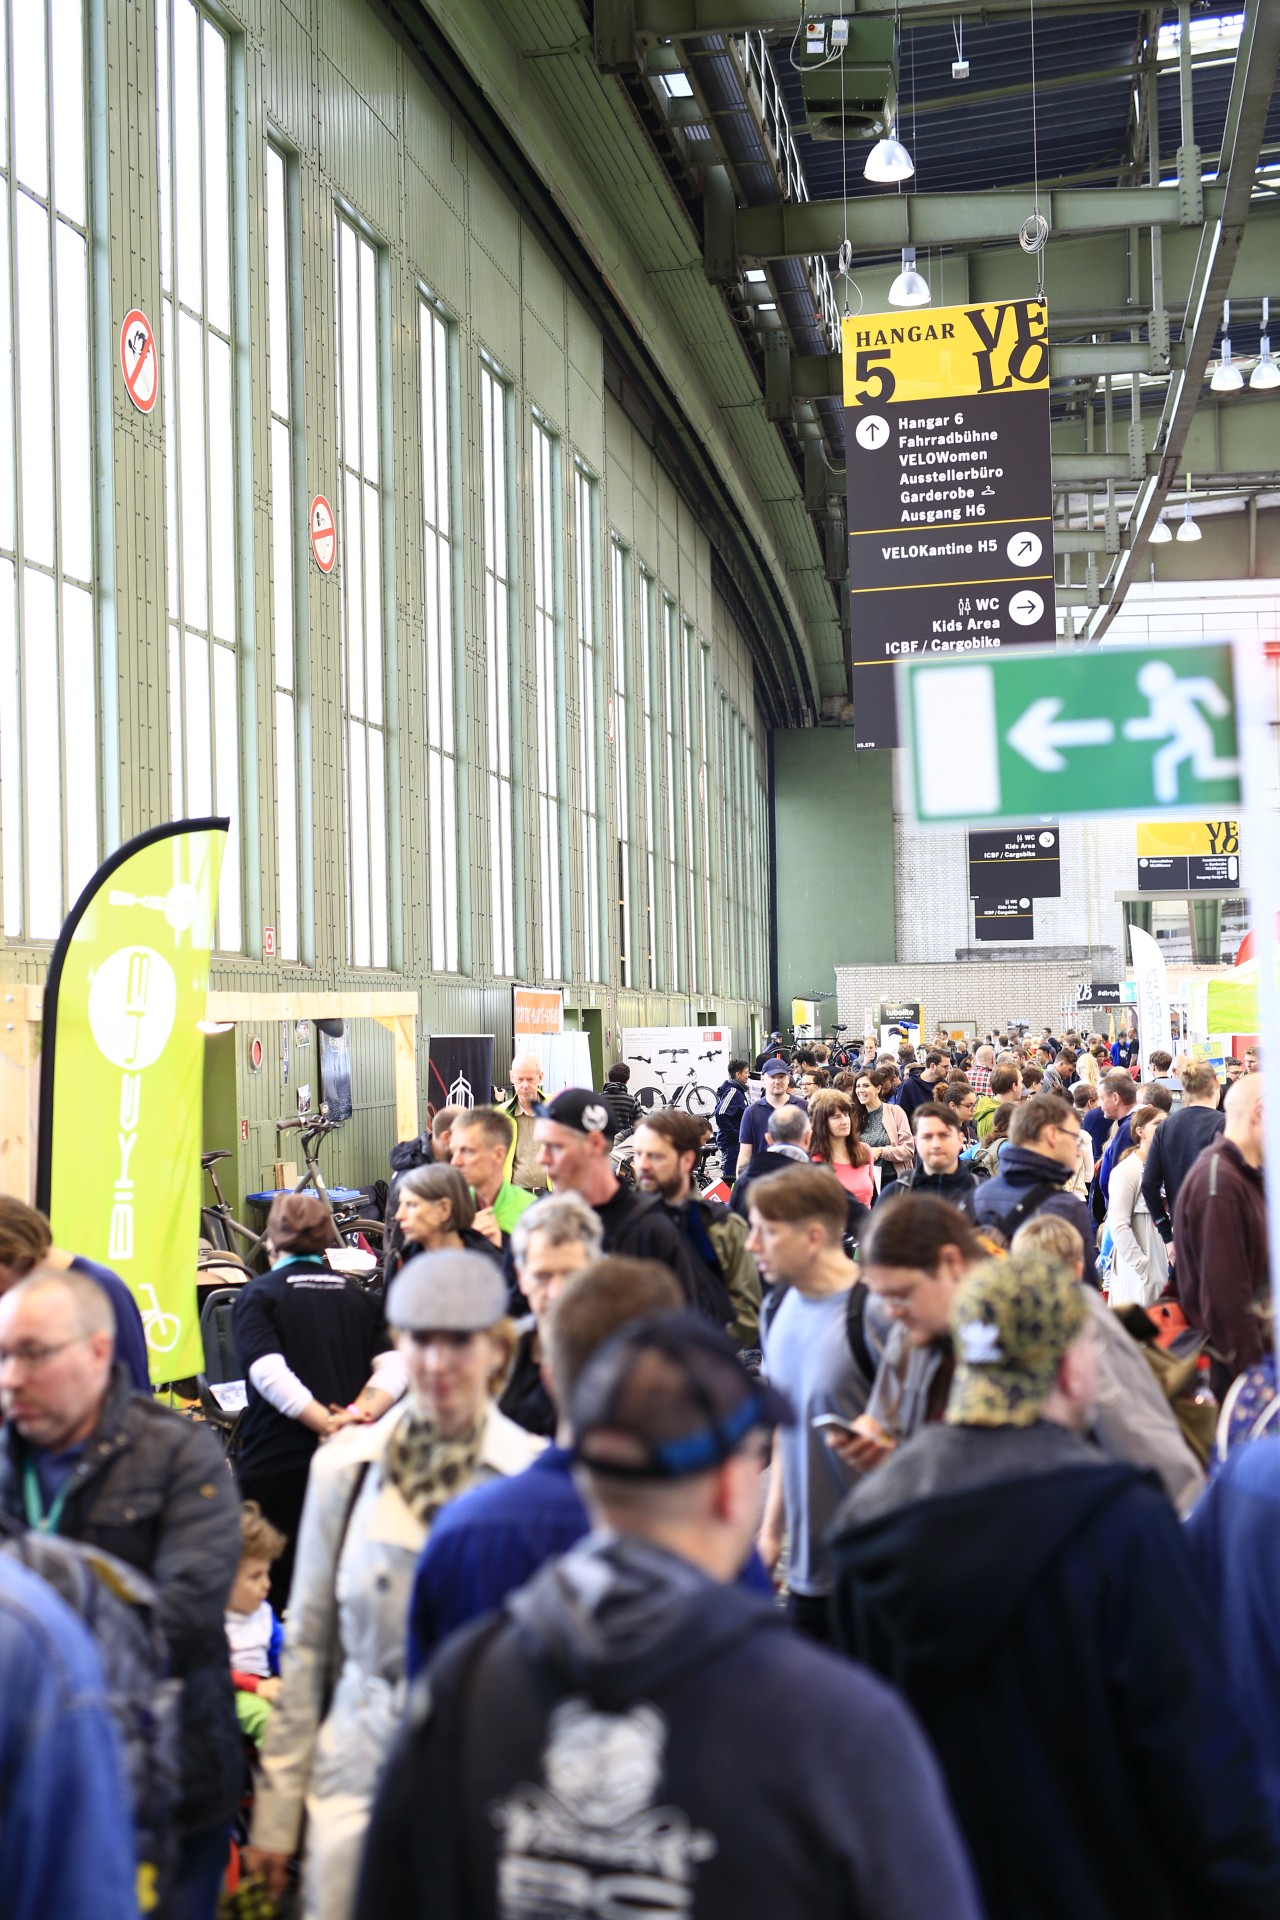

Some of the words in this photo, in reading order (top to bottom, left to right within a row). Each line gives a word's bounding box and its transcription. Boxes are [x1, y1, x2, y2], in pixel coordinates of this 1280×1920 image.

[856, 323, 955, 348] HANGAR
[855, 348, 896, 405] 5
[899, 415, 949, 430] Hangar
[954, 412, 964, 425] 6
[899, 429, 998, 449] Fahrradbühne
[899, 449, 988, 467] VELOWomen
[900, 466, 1004, 486] Ausstellerbüro
[900, 486, 975, 504] Garderobe
[901, 506, 961, 523] Ausgang
[965, 503, 986, 517] H6
[882, 542, 973, 560] VELOKantine
[978, 539, 998, 553] H5
[975, 597, 1000, 611] WC
[932, 619, 963, 633] Kids
[967, 617, 1001, 631] Area
[885, 640, 919, 655] ICBF
[930, 636, 1001, 653] Cargobike
[1004, 850, 1036, 859] Cargobike
